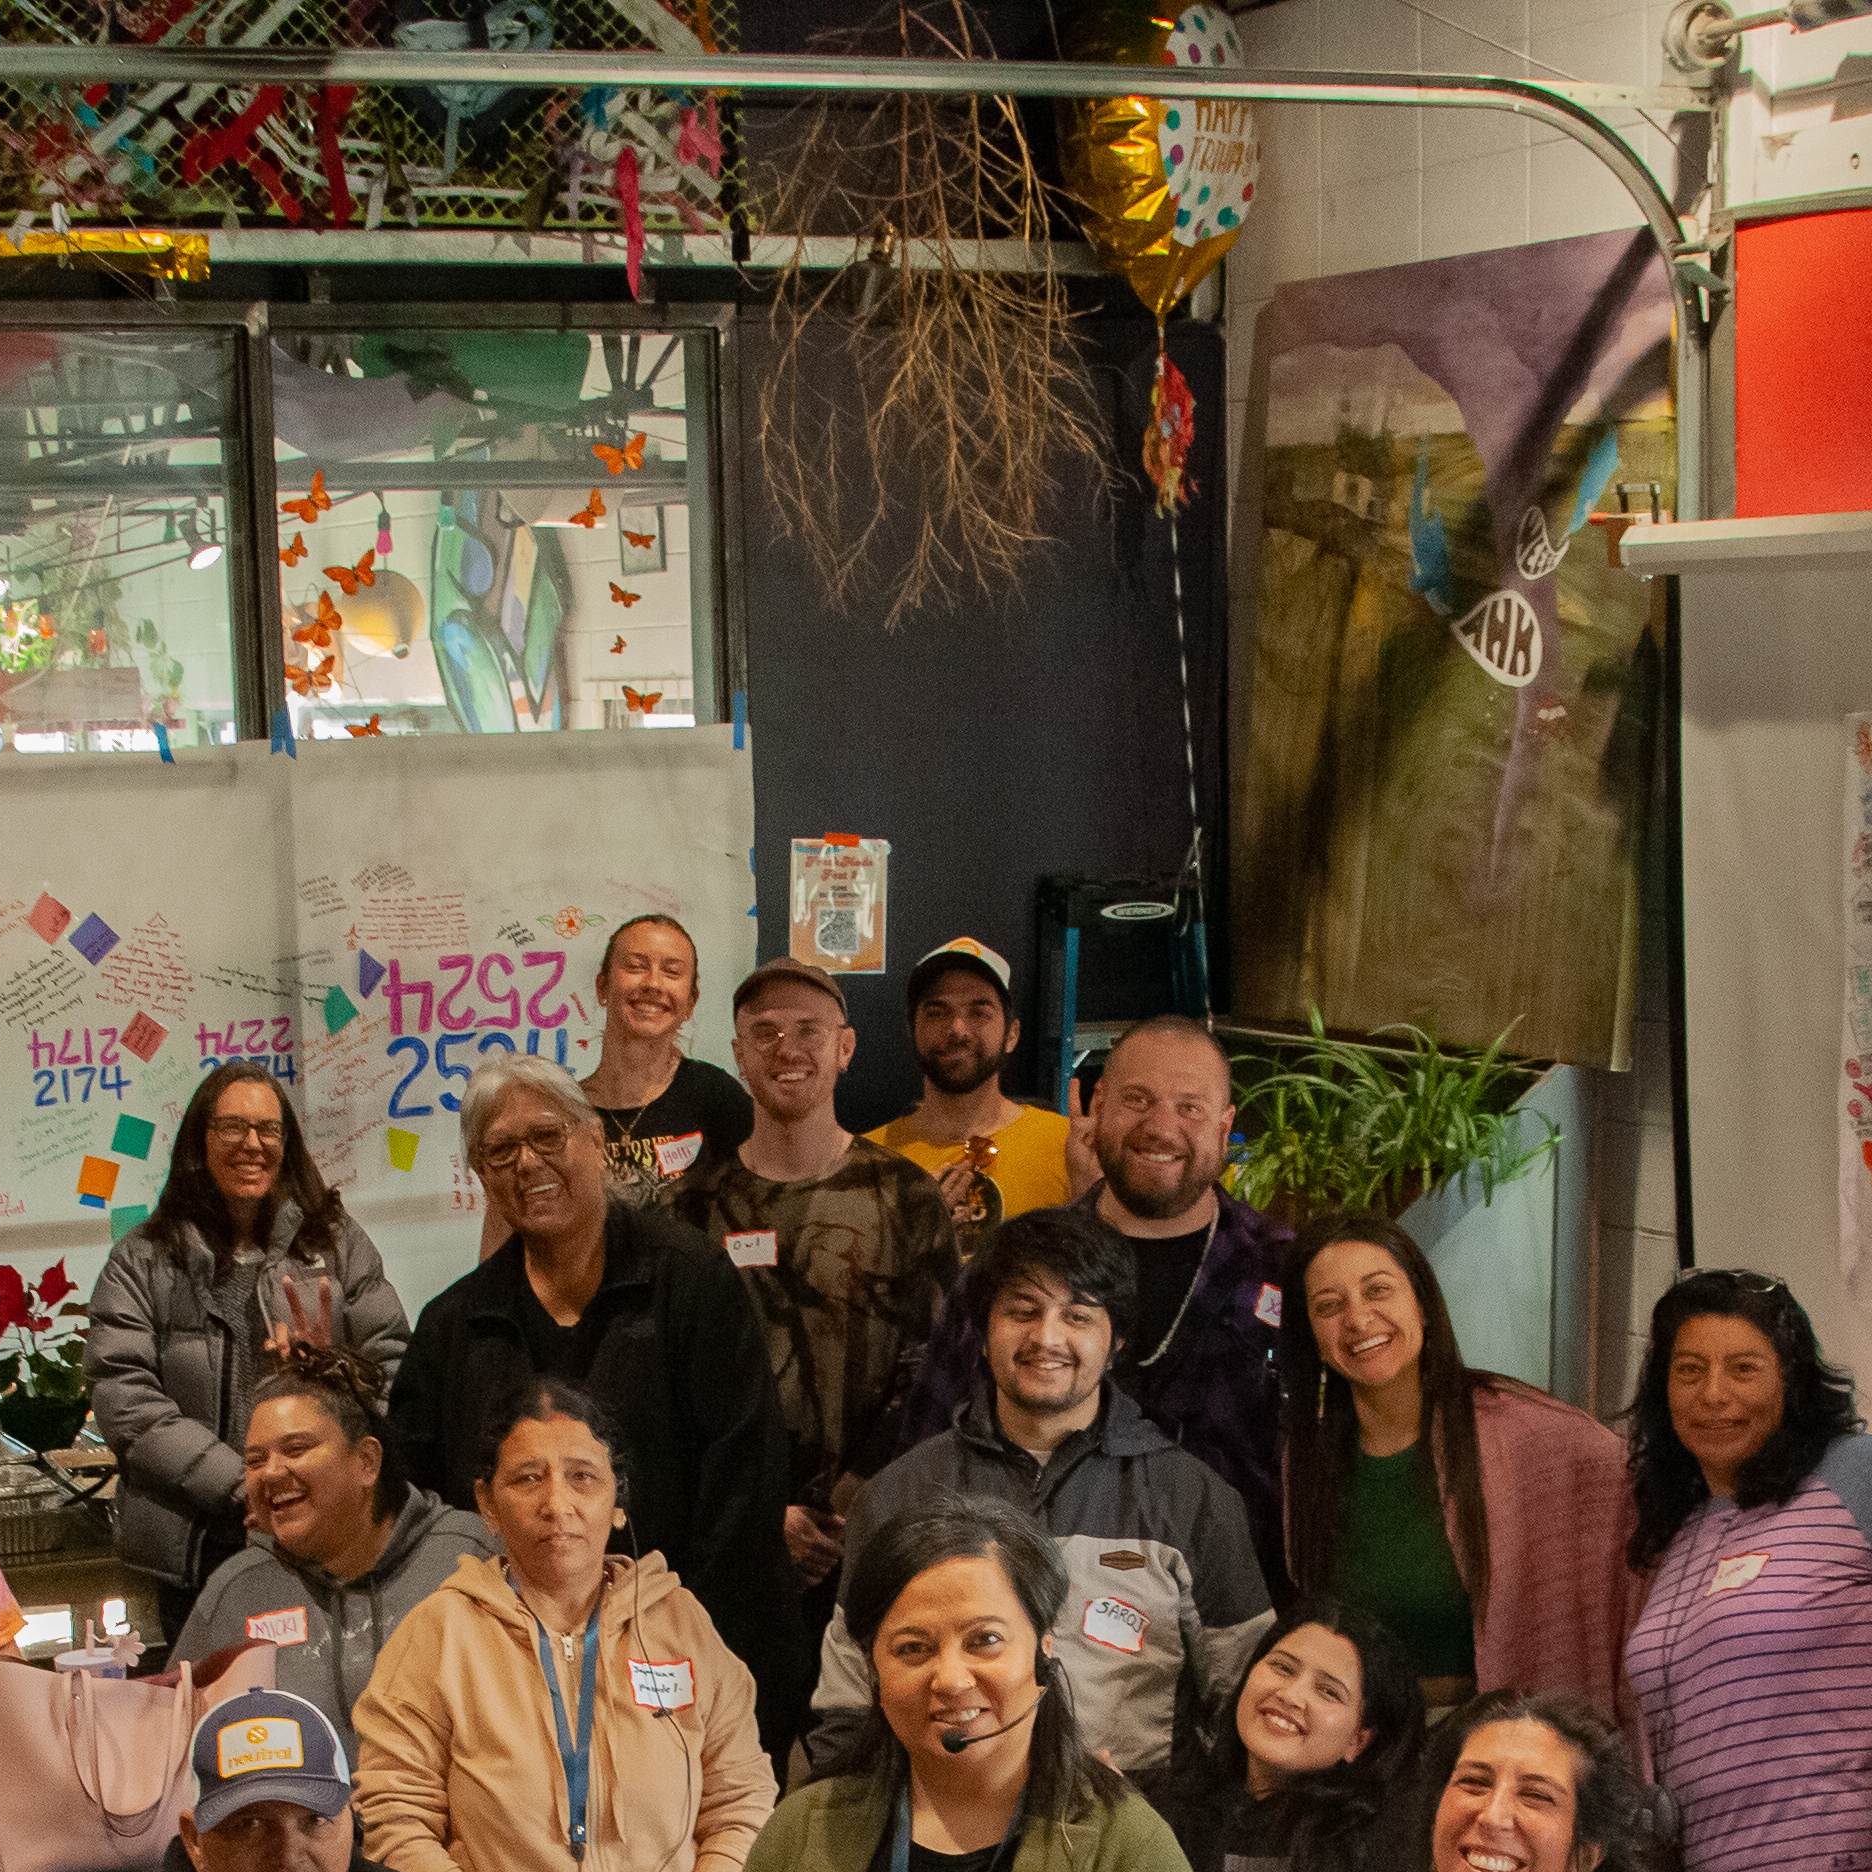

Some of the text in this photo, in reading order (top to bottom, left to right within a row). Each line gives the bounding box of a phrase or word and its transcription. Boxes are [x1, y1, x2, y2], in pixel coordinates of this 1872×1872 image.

[382, 951, 571, 1036] 2524
[27, 1027, 121, 1070] 2174
[194, 1016, 296, 1057] 2274
[32, 1065, 133, 1108] 2174
[1095, 1601, 1148, 1634] SAROJ
[227, 1747, 293, 1769] neutral
